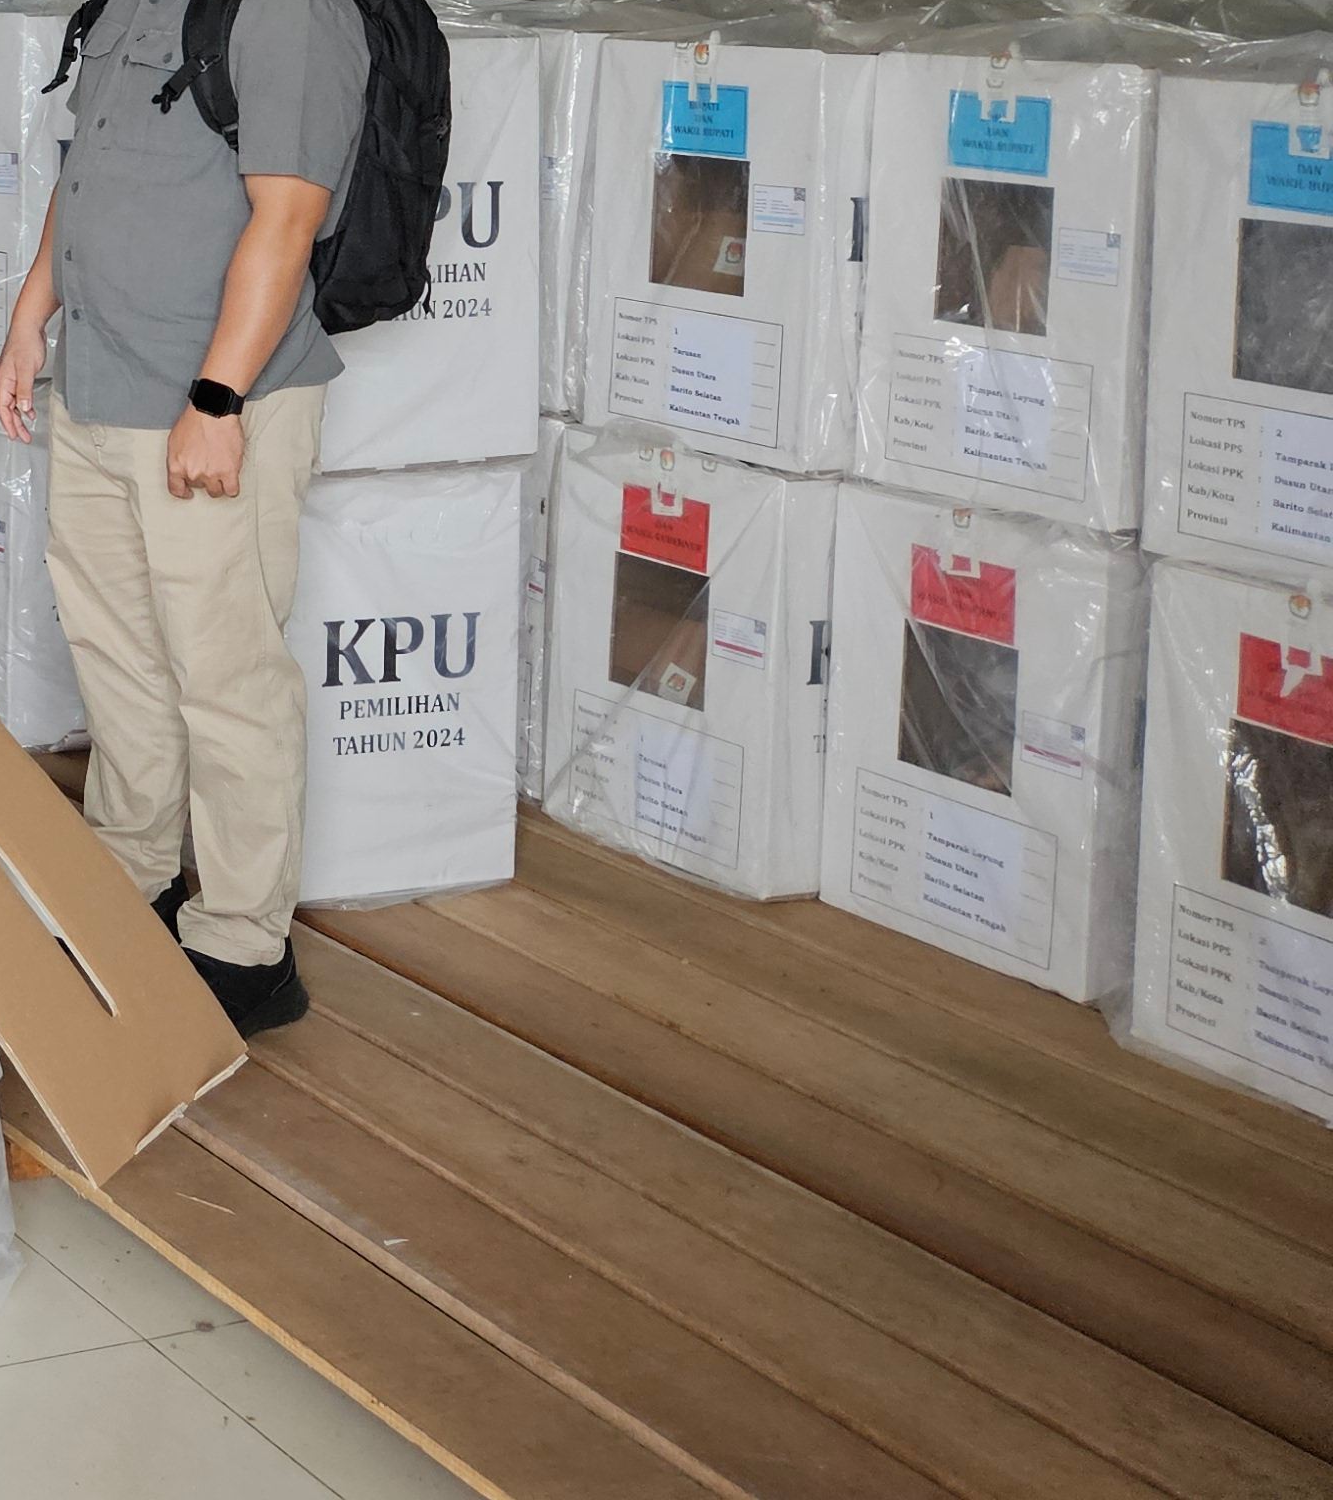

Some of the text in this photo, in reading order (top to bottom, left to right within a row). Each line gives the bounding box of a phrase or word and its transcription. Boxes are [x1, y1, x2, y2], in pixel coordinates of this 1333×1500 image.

[1309, 181, 1333, 192] BUP
[443, 298, 492, 319] 2024
[669, 404, 711, 419] Kalimantan
[714, 413, 740, 426] Tengah
[996, 411, 1020, 422] Utaa
[1190, 411, 1282, 437] Nomor TPS 2
[1189, 435, 1326, 470] Lokasi PPS Tamparak
[1188, 459, 1333, 494] Lokasi PPK Dusun Utar
[1188, 484, 1333, 519] Kab/Kota Barito Selat
[1187, 509, 1331, 543] Provinsi Kalimantan
[322, 612, 481, 687] KPU
[340, 692, 460, 720] PEMILIHAN
[333, 727, 465, 755] TAHUN 2024
[1215, 917, 1234, 932] TPS
[1212, 941, 1232, 957] PPS
[1210, 966, 1232, 982] PPK
[1177, 978, 1224, 1005] Kab/Kota
